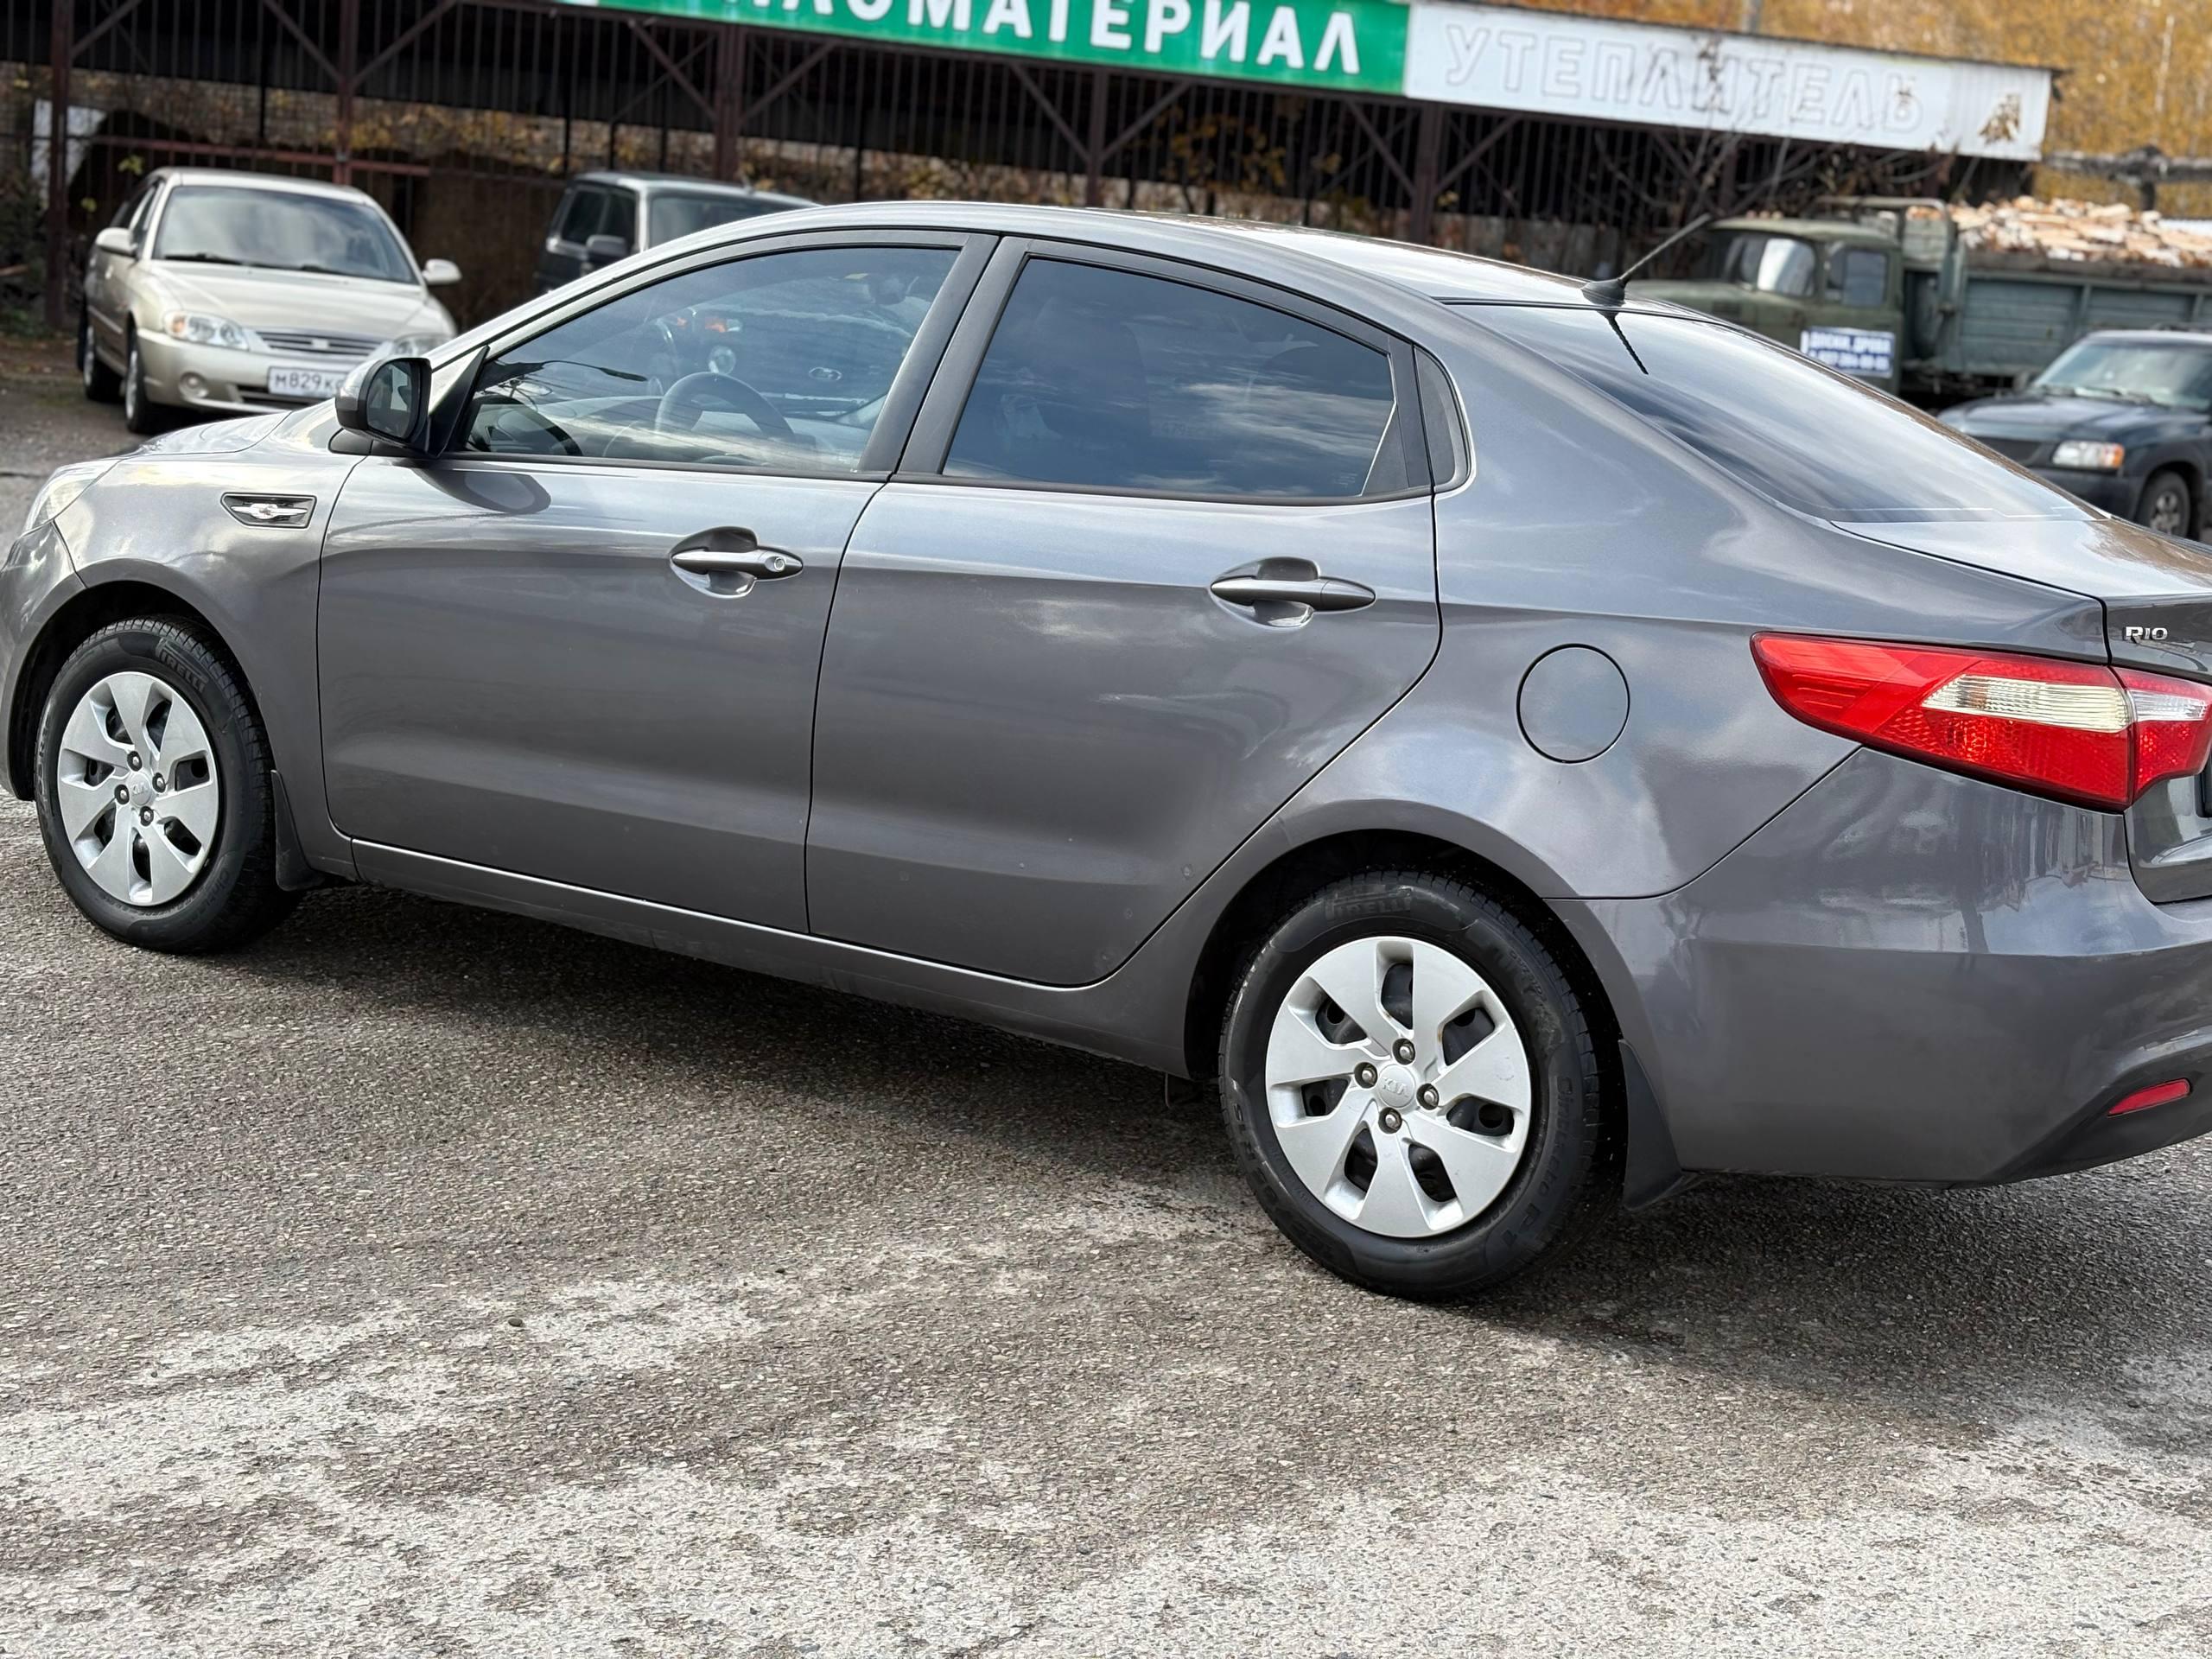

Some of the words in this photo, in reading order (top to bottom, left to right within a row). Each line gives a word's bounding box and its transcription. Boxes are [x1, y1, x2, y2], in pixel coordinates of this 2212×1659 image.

[723, 0, 1360, 74] МАТЕРИАЛ
[1446, 23, 1924, 133] УТЕПЛИТЕЛЬ
[2124, 626, 2168, 644] RIO
[1382, 1077, 1409, 1098] KIA
